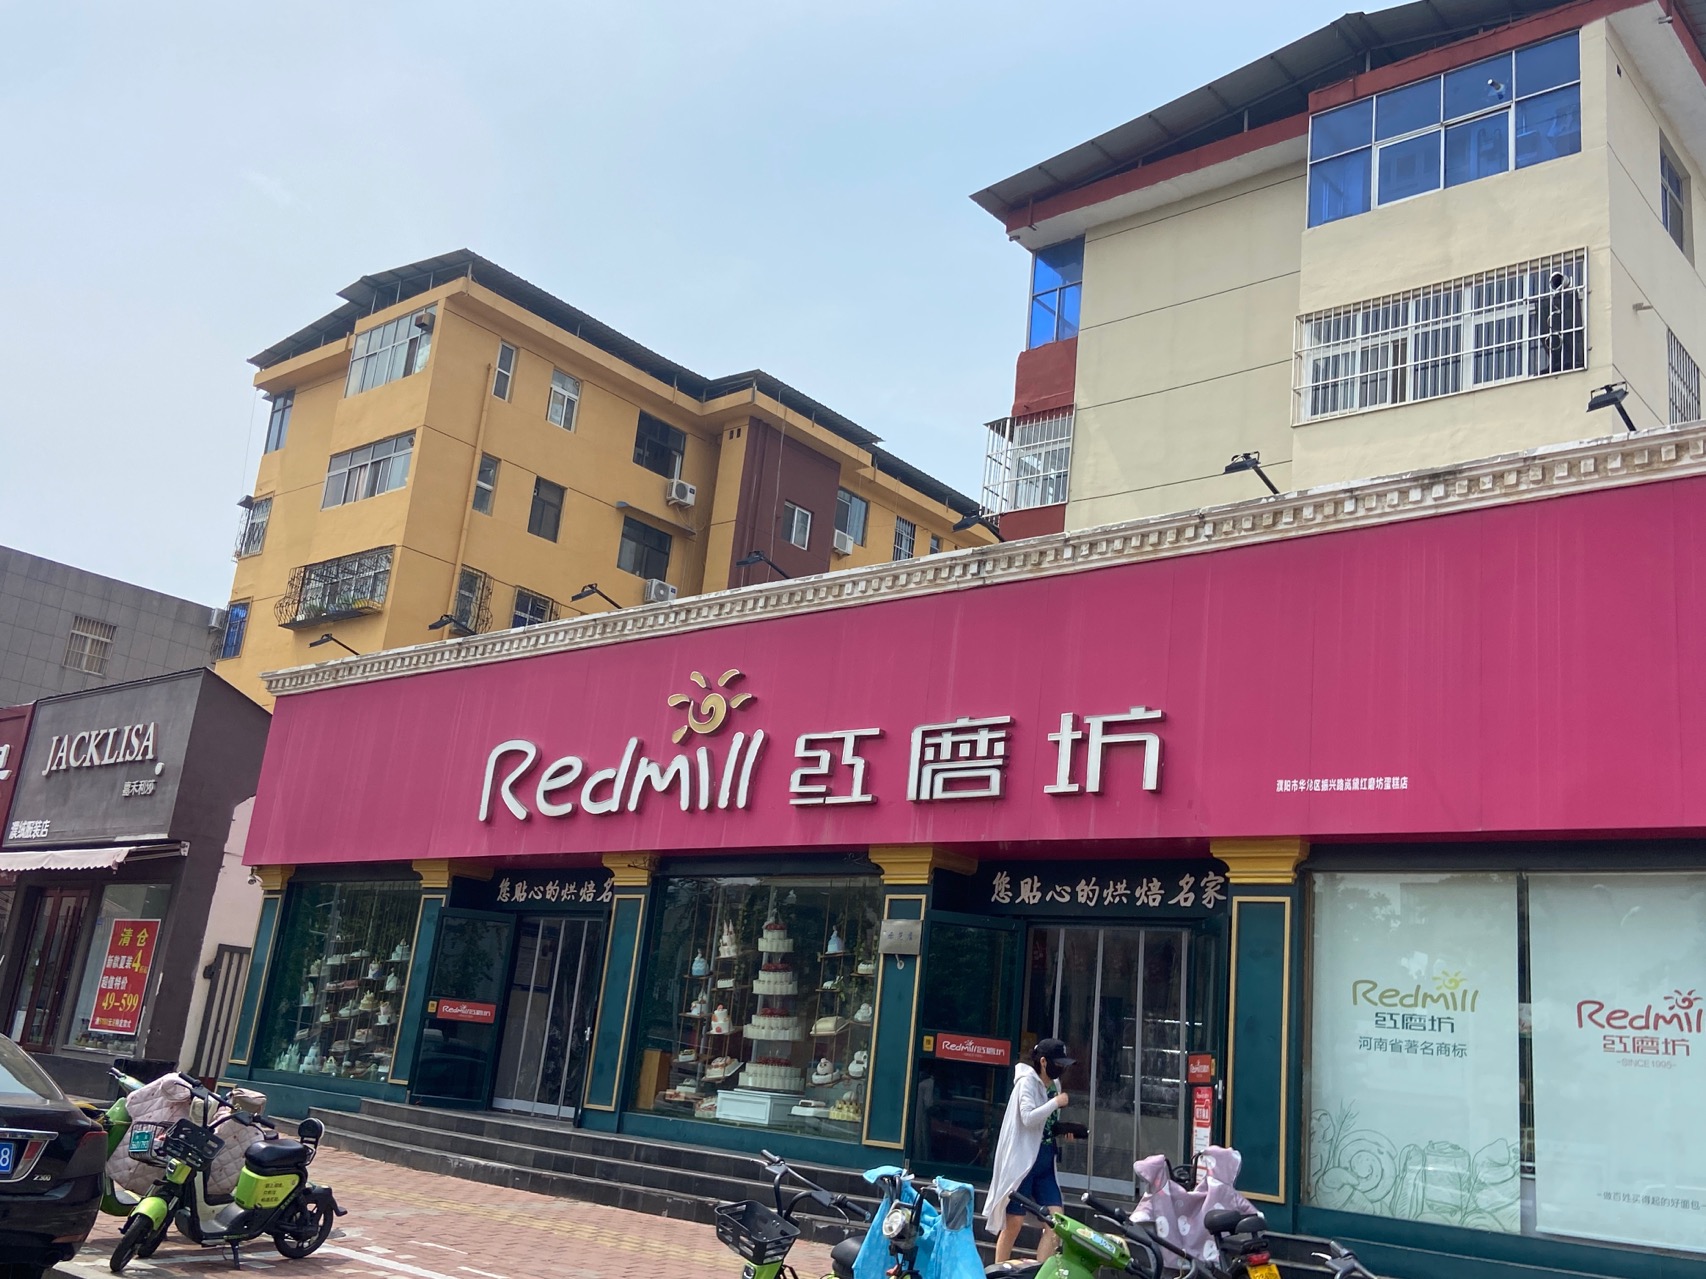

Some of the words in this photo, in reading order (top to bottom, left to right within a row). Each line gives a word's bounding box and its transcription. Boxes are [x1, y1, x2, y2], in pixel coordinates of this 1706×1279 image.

[42, 722, 157, 777] JACKLISA
[479, 728, 767, 822] Redmill
[790, 706, 1166, 806] 红磨坊
[991, 870, 1227, 909] 您贴心的烘焙名家
[118, 928, 149, 947] 清仓
[1352, 979, 1479, 1012] Redmill
[1374, 1011, 1455, 1033] 红磨坊
[1358, 1035, 1468, 1059] 河南省著名商标
[1602, 1034, 1690, 1056] 红磨坊
